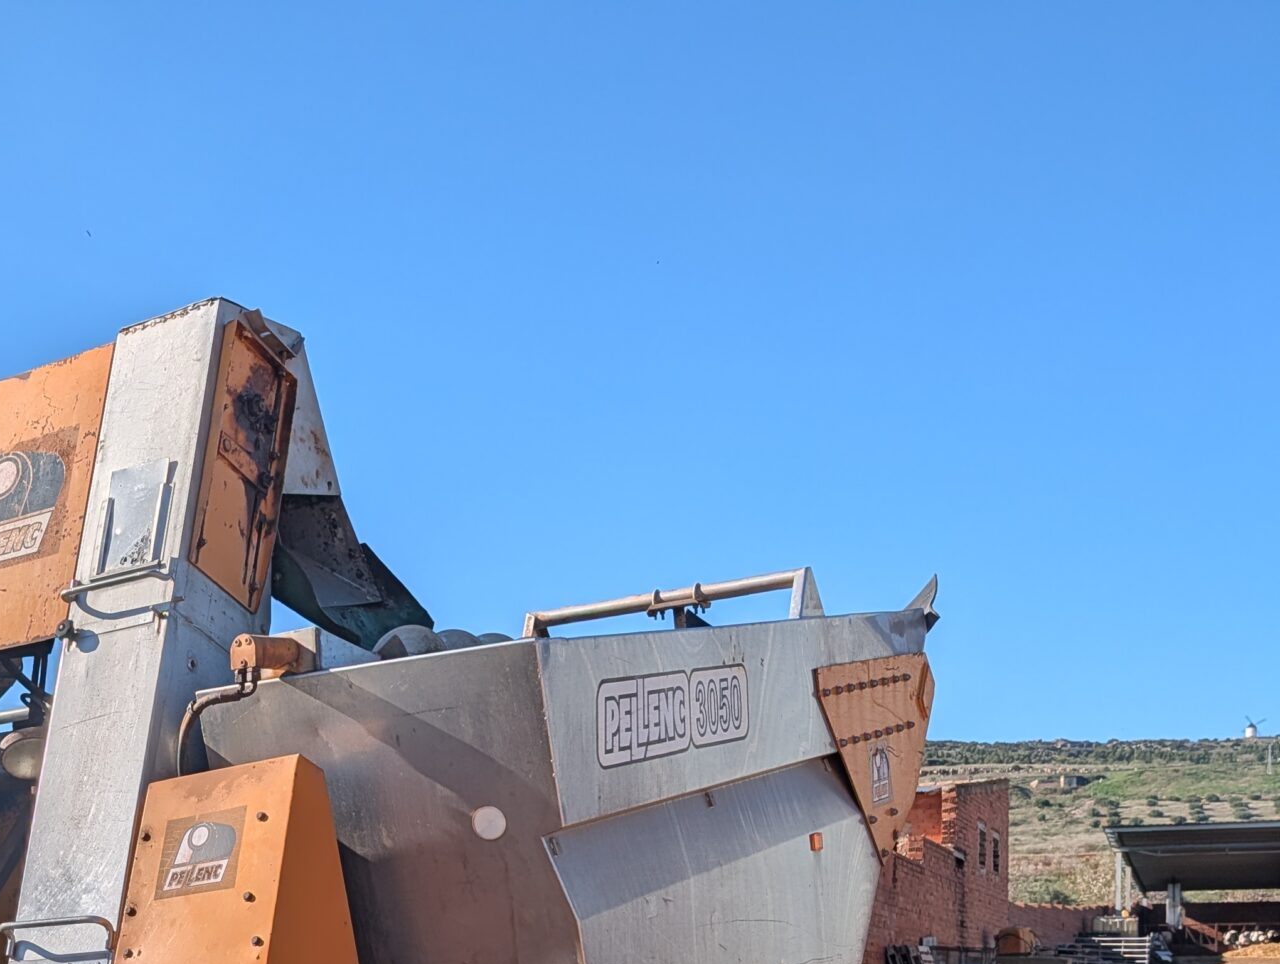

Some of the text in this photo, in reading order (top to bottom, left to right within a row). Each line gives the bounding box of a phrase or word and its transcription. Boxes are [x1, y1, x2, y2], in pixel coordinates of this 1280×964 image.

[604, 675, 742, 761] PELLENC 3050
[166, 863, 223, 887] PELLENC
